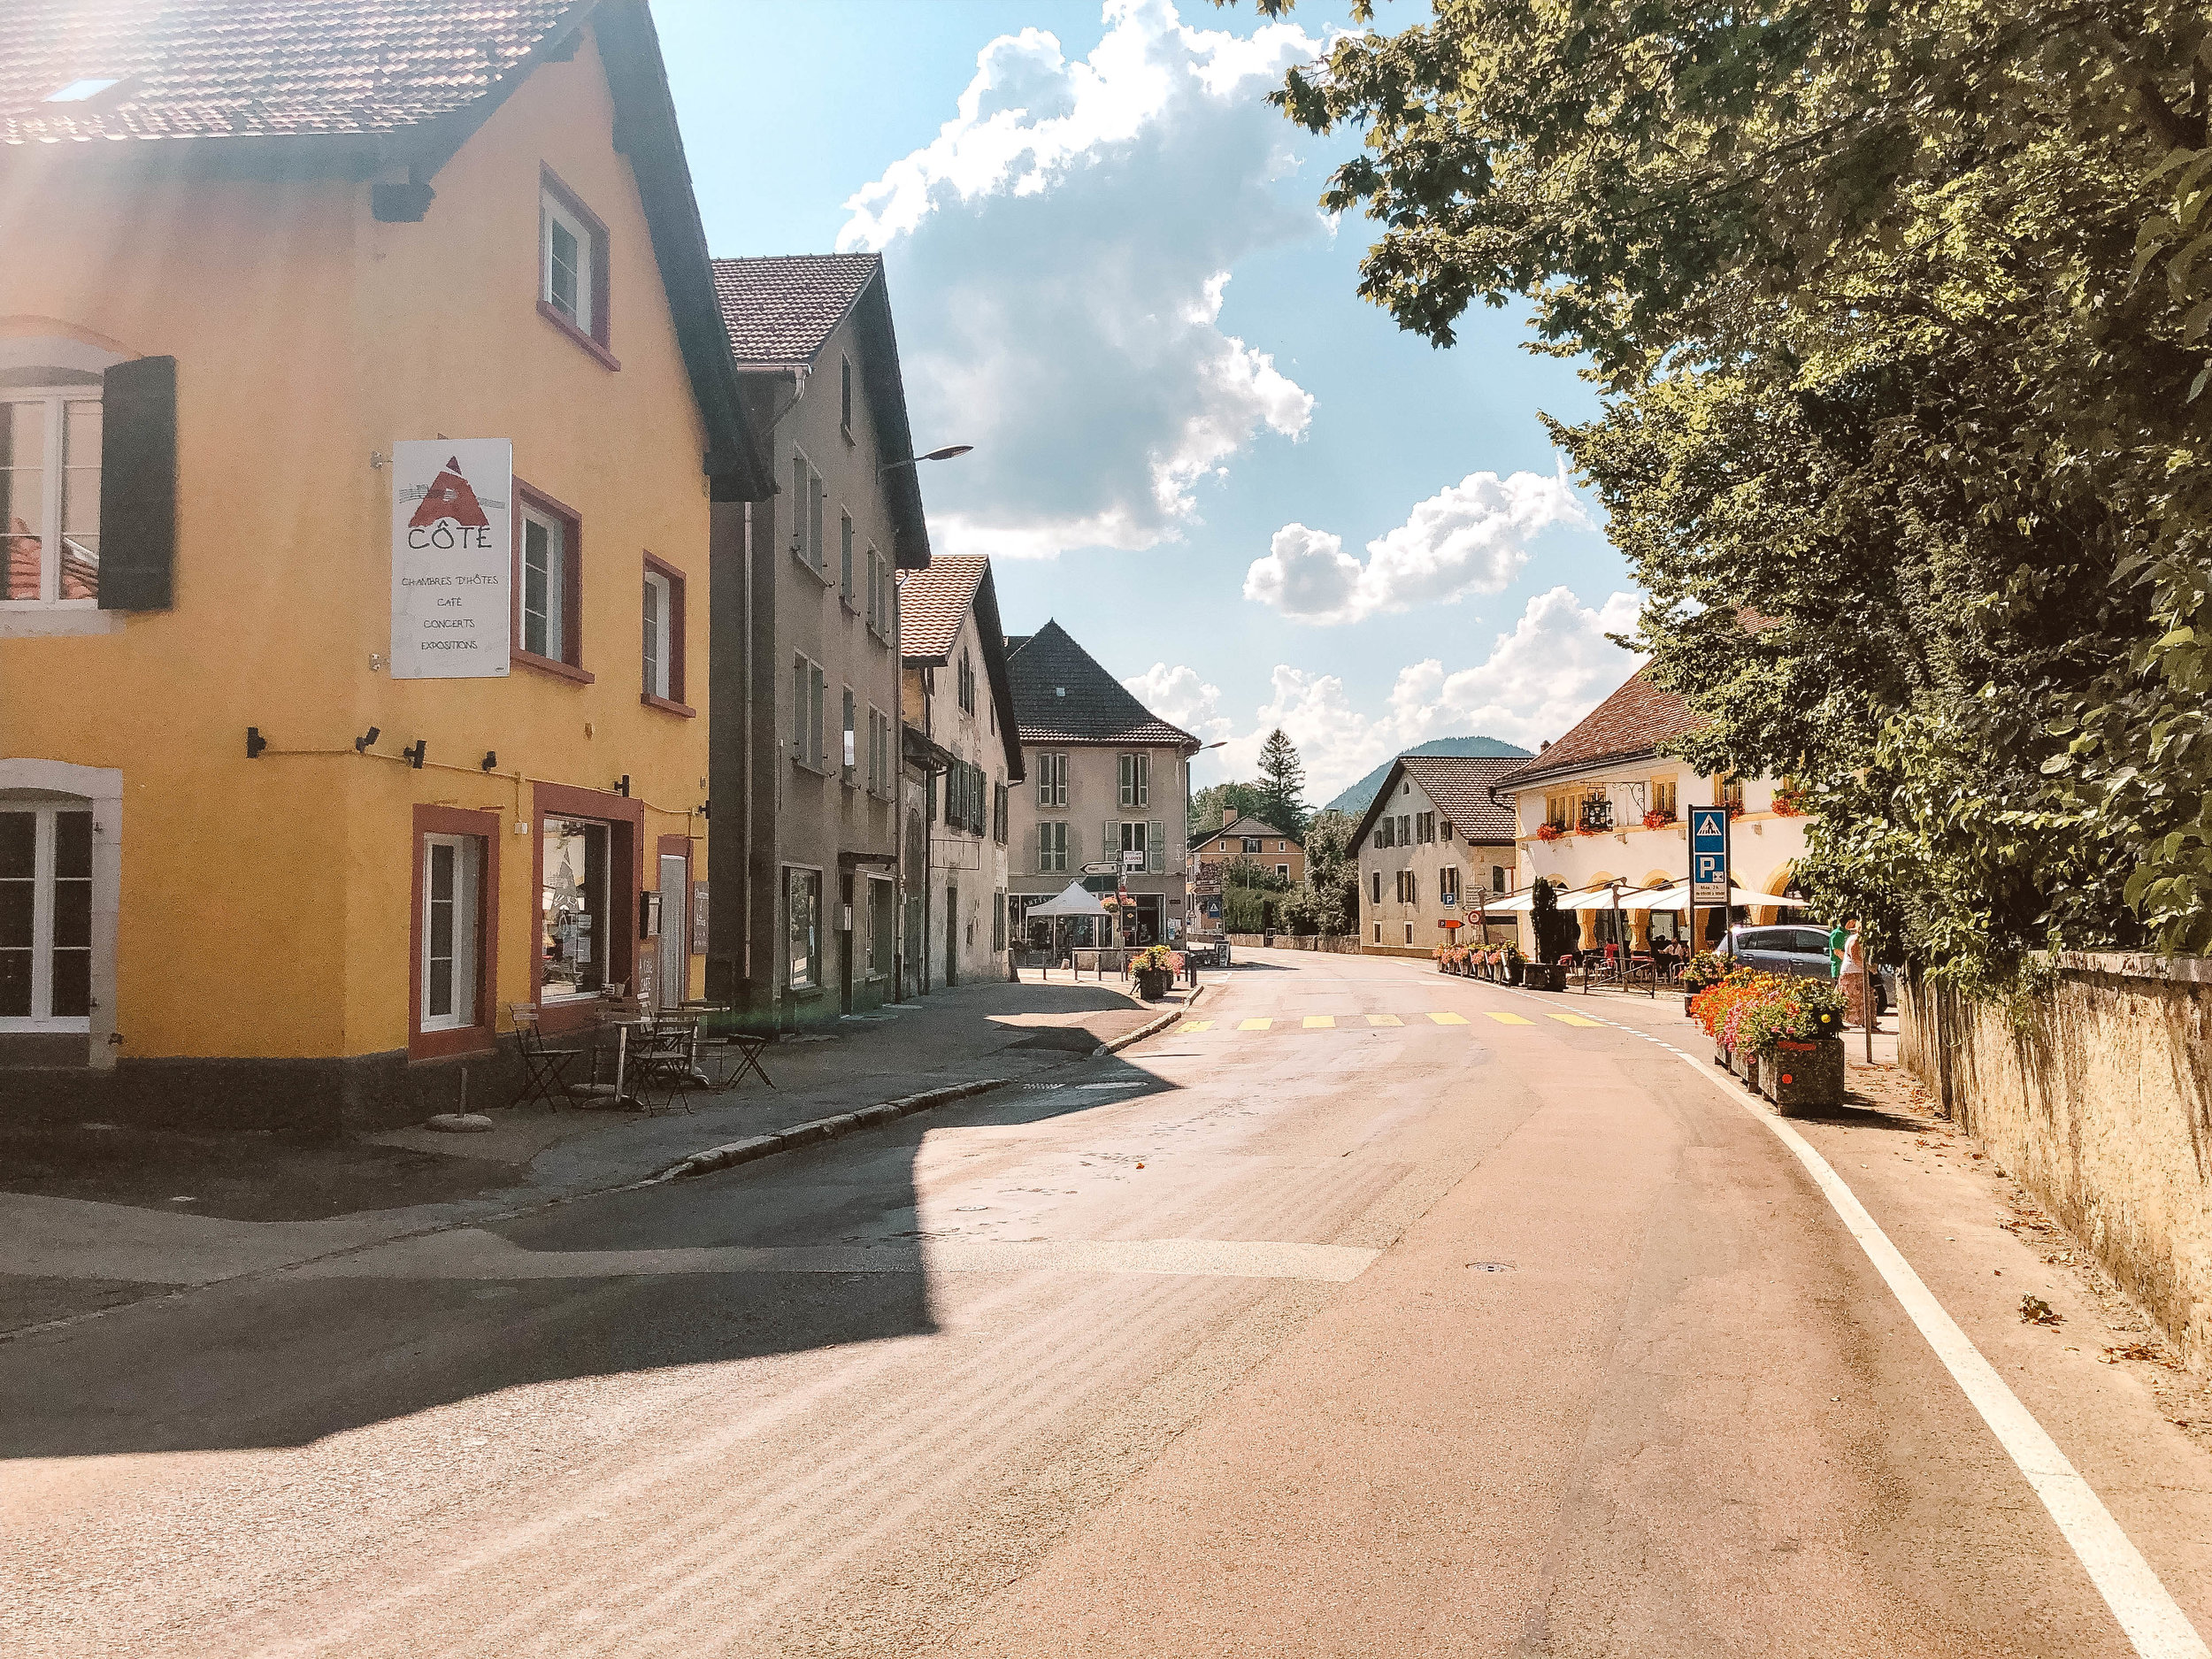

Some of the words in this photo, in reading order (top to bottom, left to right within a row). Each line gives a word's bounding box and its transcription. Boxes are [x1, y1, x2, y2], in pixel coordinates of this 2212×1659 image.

[402, 576, 452, 587] CHAMBRES
[457, 573, 499, 586] D'HÔTES
[423, 618, 475, 629] CONCERTS
[421, 641, 478, 651] EXPOSITIONS
[1700, 856, 1715, 879] P
[1447, 895, 1452, 904] P
